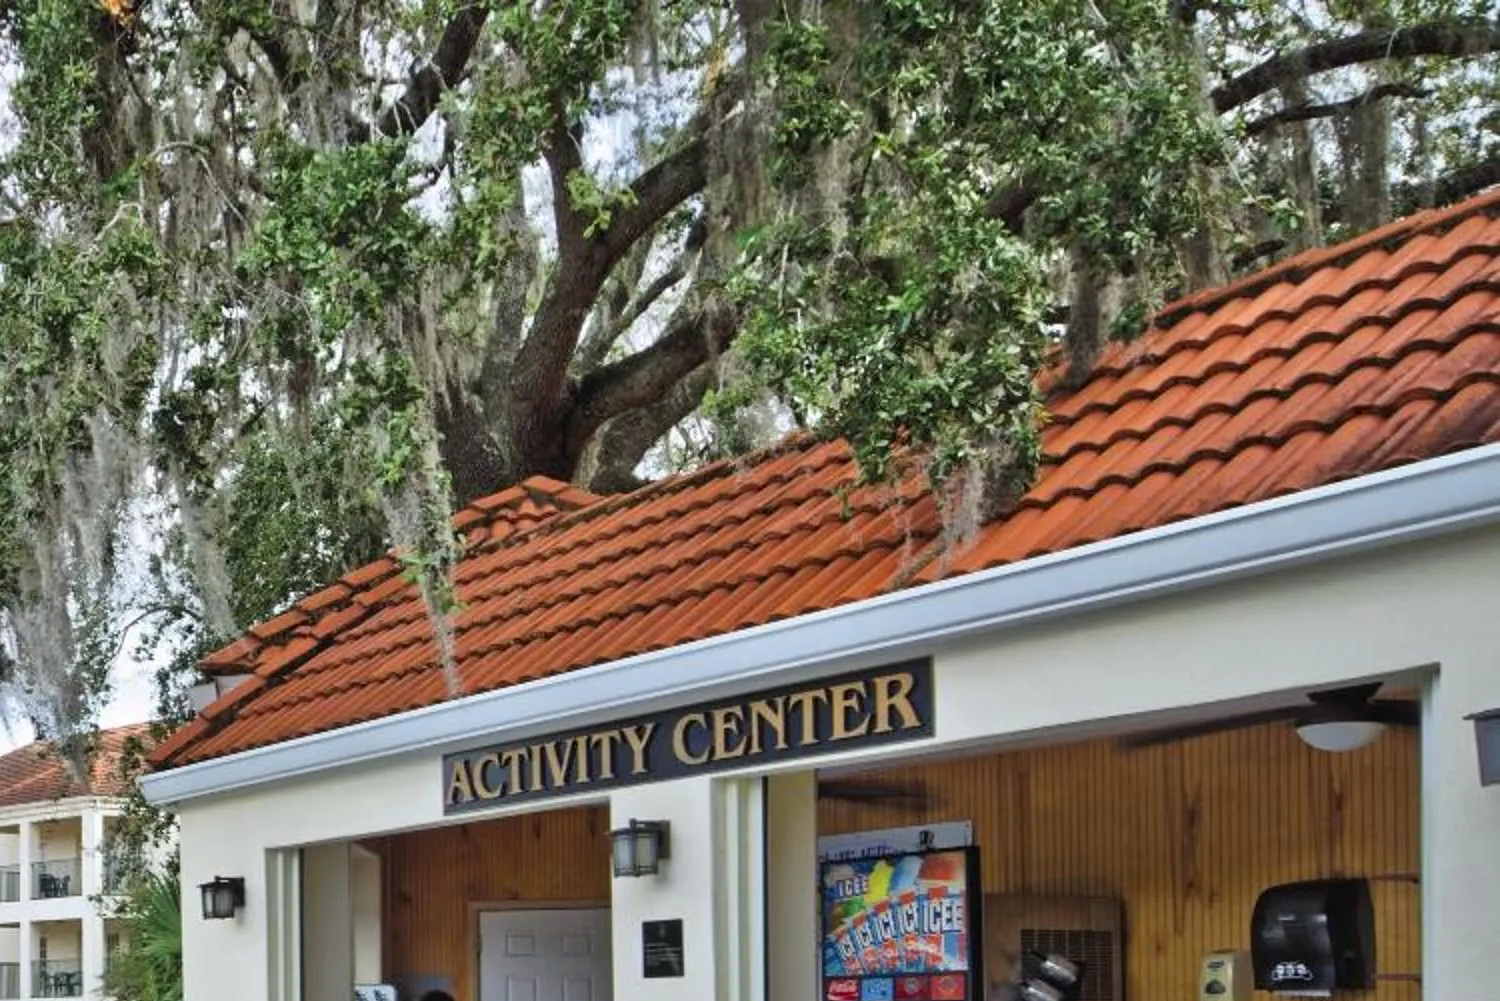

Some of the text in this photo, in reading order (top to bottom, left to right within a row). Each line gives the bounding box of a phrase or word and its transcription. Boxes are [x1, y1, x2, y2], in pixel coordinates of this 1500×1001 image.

[446, 671, 924, 805] ACTIVITY CENTER
[837, 874, 869, 898] ICEE
[924, 898, 964, 933] ICEE
